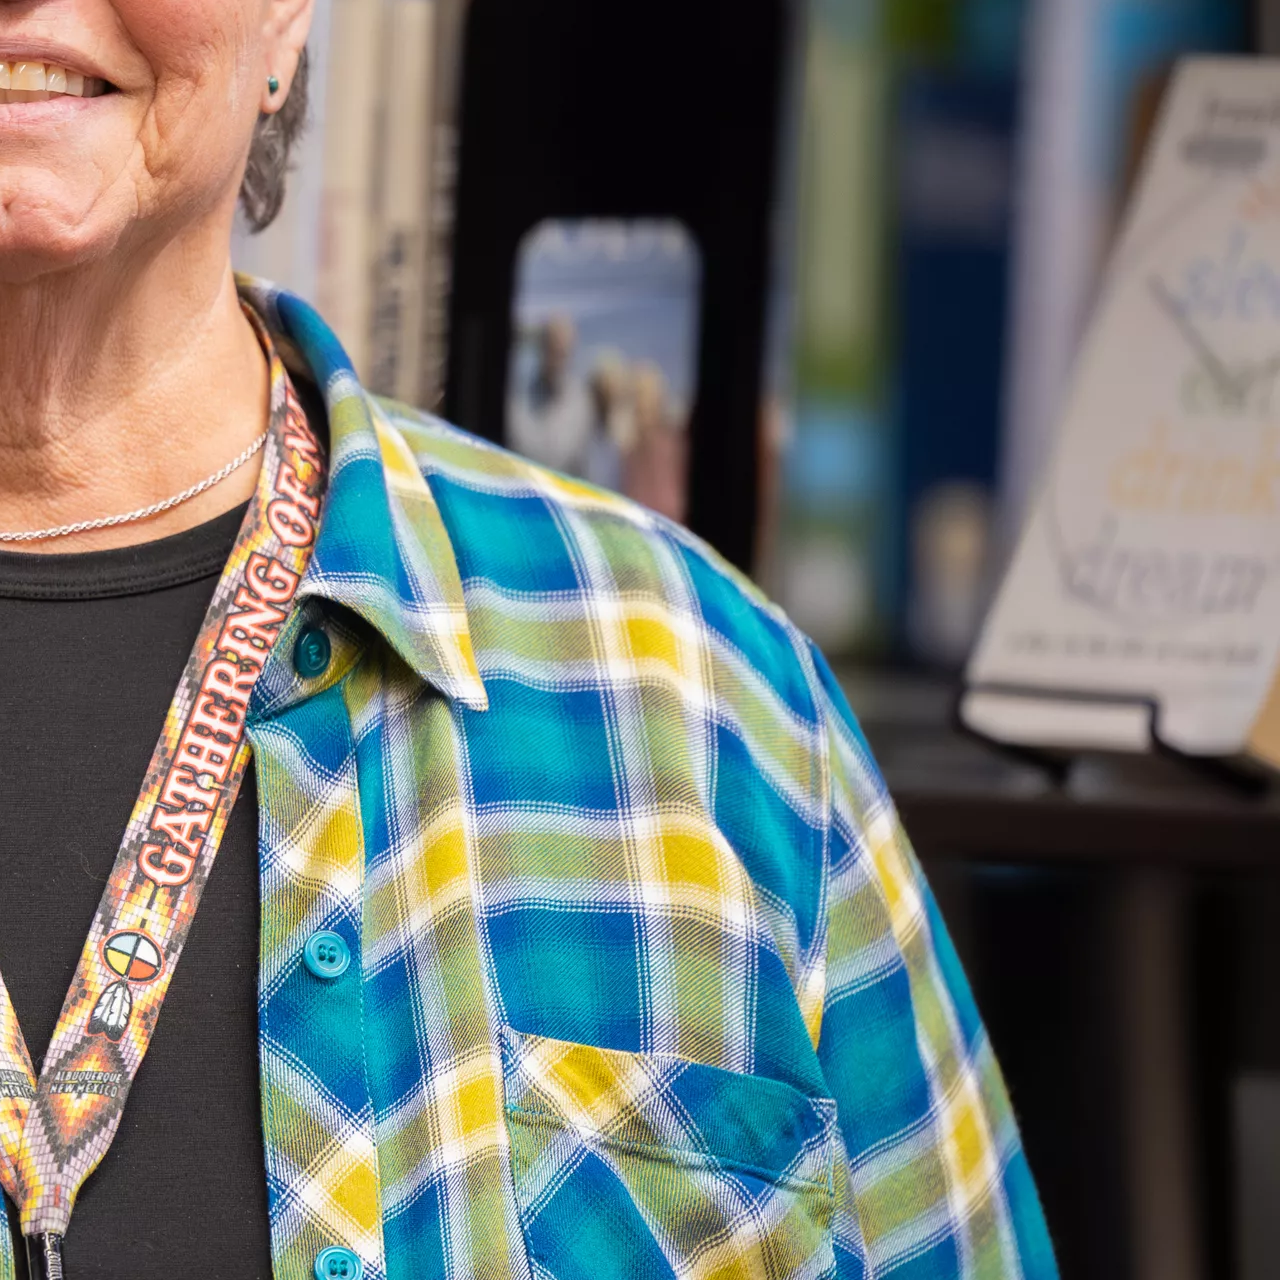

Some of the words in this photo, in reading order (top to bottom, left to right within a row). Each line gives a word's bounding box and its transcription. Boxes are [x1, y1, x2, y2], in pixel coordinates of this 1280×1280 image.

[136, 550, 302, 887] GATHERING
[266, 461, 320, 549] OF
[54, 1070, 122, 1084] ALBUQUERQUE
[50, 1083, 74, 1095] NEW
[77, 1084, 118, 1098] MEXICO
